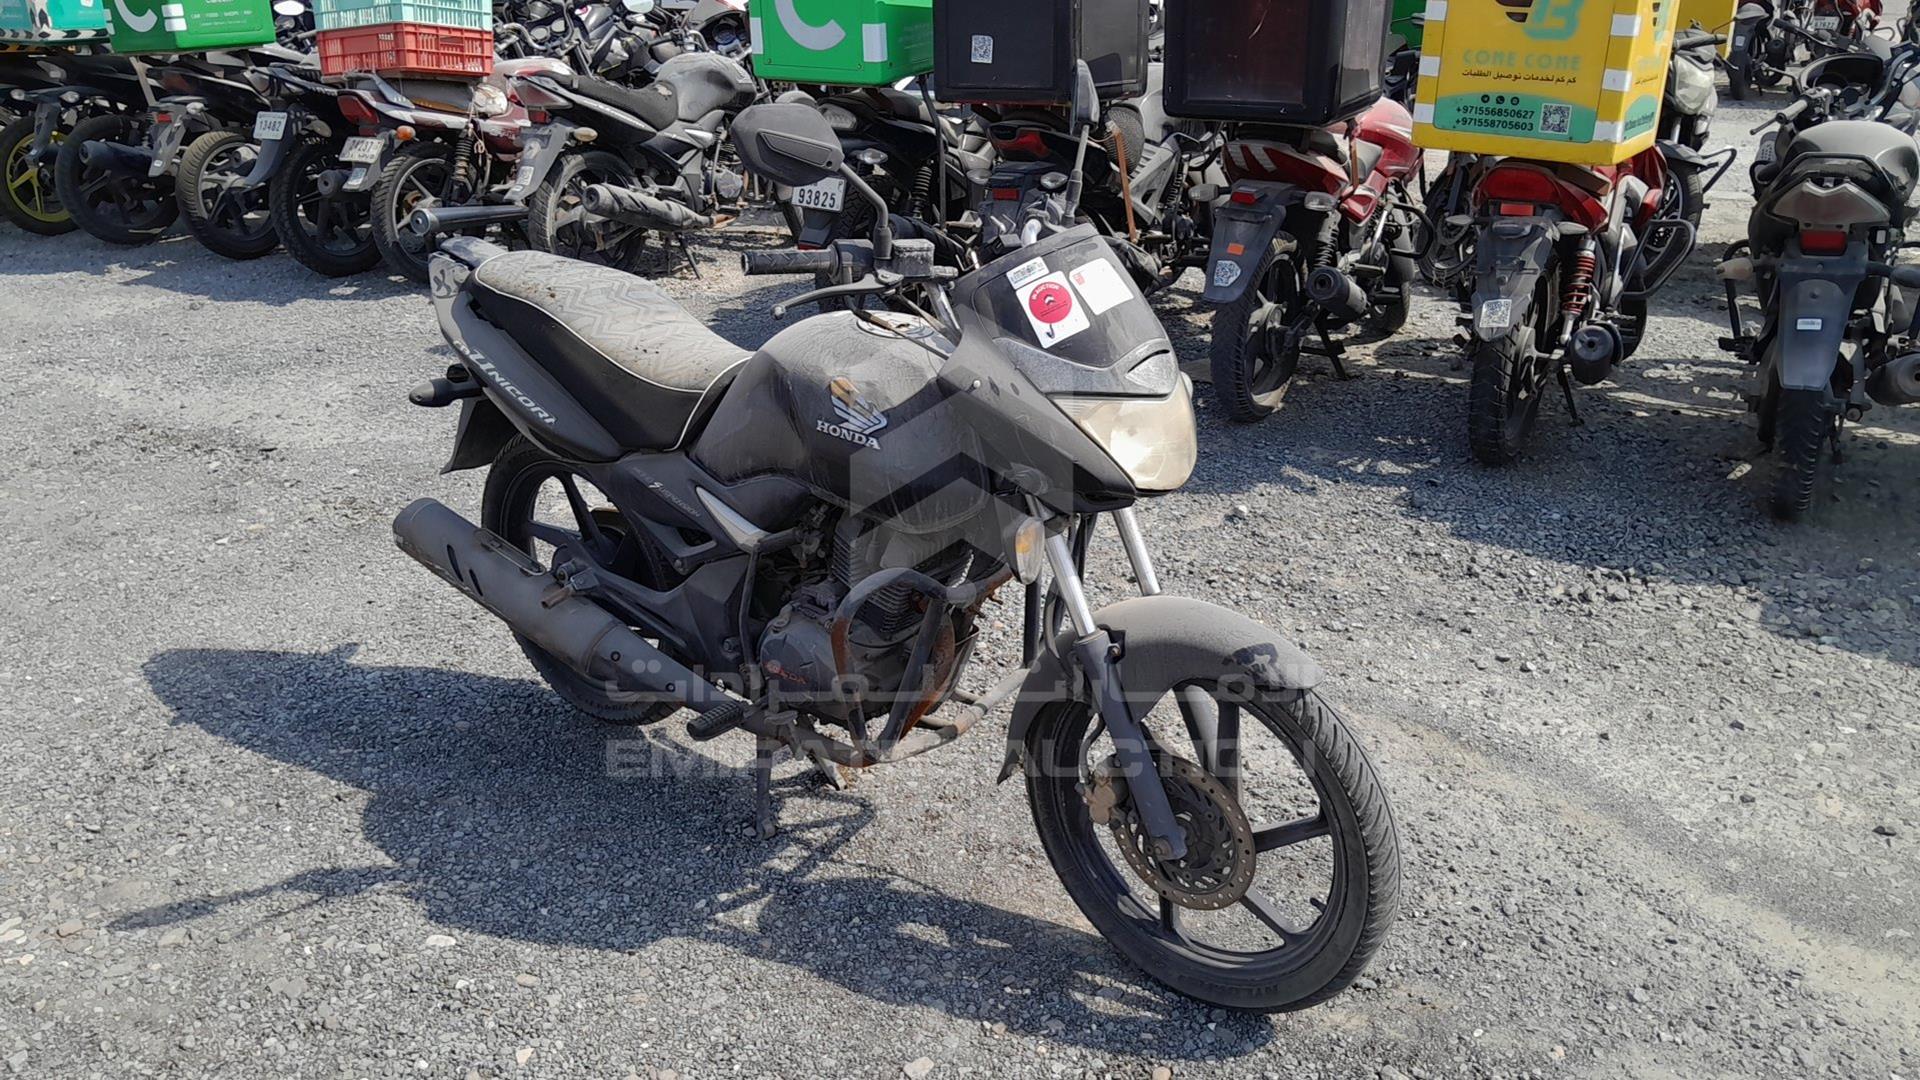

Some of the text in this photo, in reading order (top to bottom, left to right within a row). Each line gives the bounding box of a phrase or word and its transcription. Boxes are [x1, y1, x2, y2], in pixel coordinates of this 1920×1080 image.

[1462, 48, 1582, 70] COME COME
[1456, 105, 1535, 119] +971556850627
[1455, 116, 1534, 131] +971558705603
[798, 188, 836, 208] 93825
[816, 419, 881, 450] HONDA
